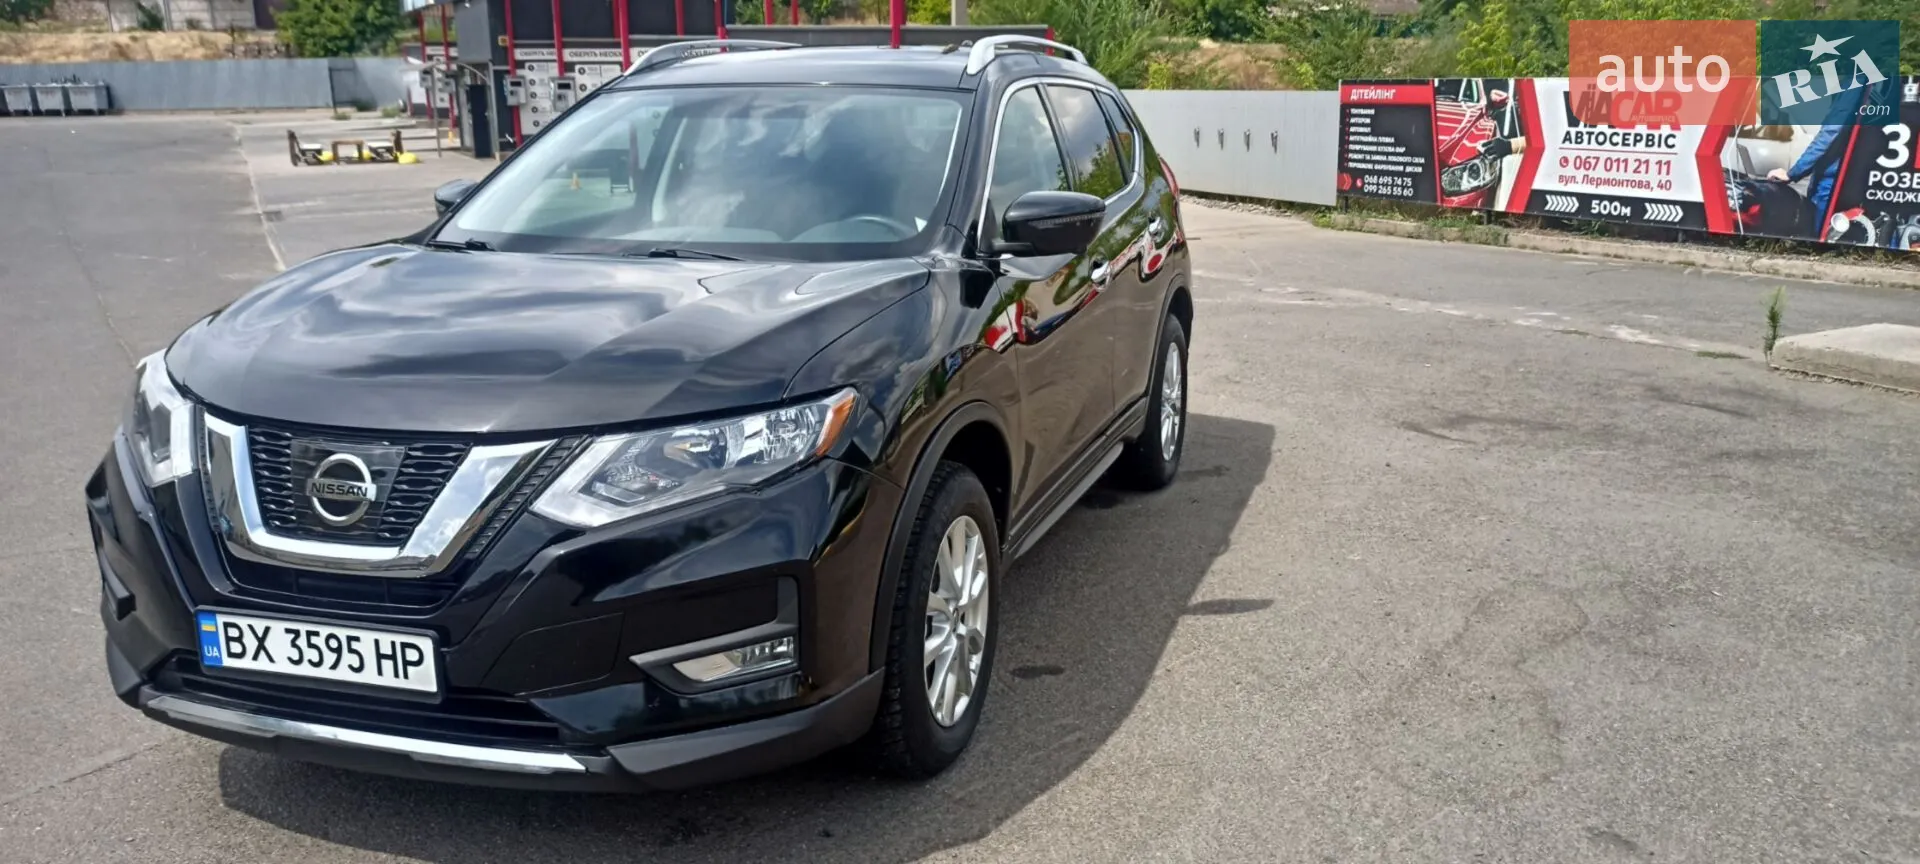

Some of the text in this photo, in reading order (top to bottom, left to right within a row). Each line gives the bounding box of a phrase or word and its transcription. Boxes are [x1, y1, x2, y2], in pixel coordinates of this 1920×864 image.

[1350, 86, 1396, 101] ДІТЕЙЛІНГ
[1561, 130, 1677, 149] АВТОСЕРВІС
[1573, 155, 1672, 176] 067 011 21 11
[1364, 175, 1412, 187] 068 695 74 75
[1558, 174, 1672, 192] вул. Лермонтова, 40
[1363, 184, 1414, 197] 099 265 55 60
[1866, 189, 1920, 204] СХОДЖ
[1590, 200, 1632, 217] 500м
[311, 482, 368, 498] NISSAN
[204, 645, 220, 658] UA
[222, 621, 424, 680] BX 3595 HP
